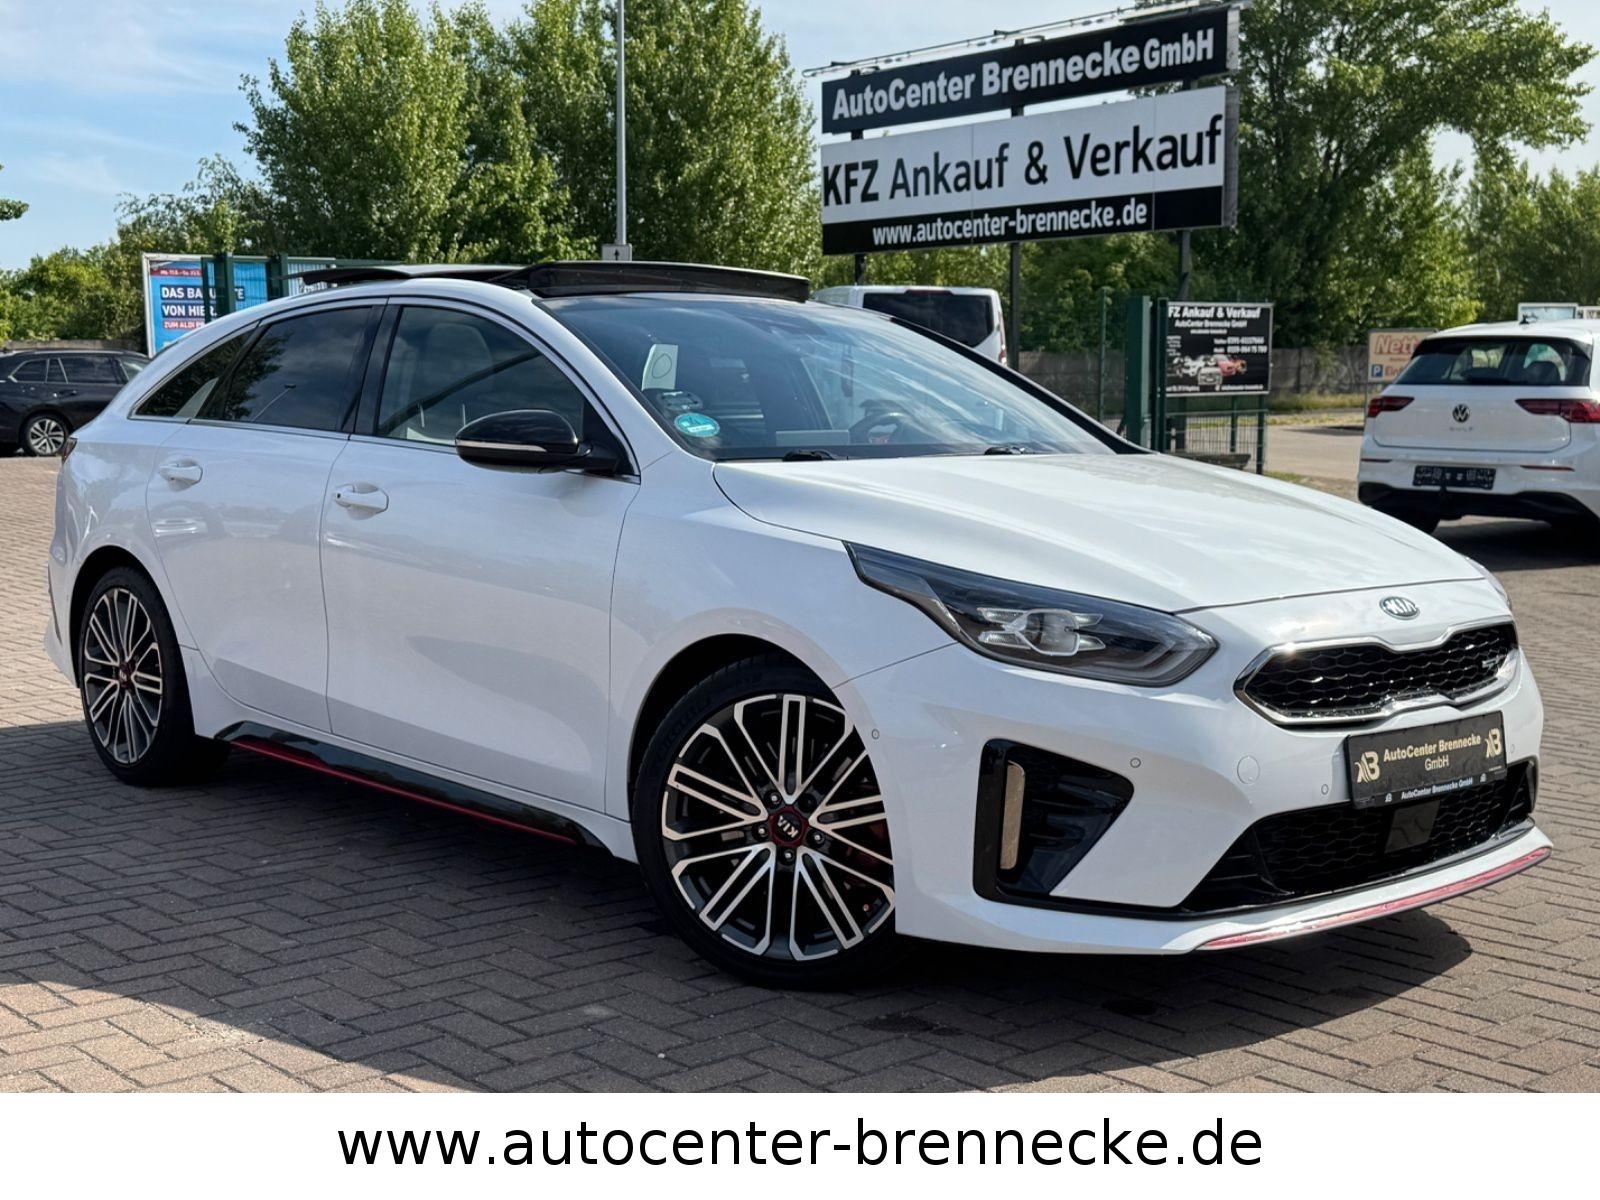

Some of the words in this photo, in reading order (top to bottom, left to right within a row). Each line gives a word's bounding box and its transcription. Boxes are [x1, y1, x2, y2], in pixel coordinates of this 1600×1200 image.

[832, 71, 976, 120] AutoCenter
[982, 40, 1140, 96] Brennecke
[1143, 28, 1215, 70] GmbH
[823, 160, 879, 207] KFZ
[889, 142, 1009, 199] Ankauf
[1024, 140, 1048, 185] &
[1064, 114, 1222, 179] Verkauf
[872, 197, 1147, 246] www.autocenter-brennecke.de
[162, 287, 185, 299] DAS
[162, 305, 186, 317] VON
[1168, 306, 1181, 318] FZ
[1182, 306, 1215, 318] Ankauf
[1226, 306, 1261, 318] Verkauf
[1374, 335, 1420, 355] Nett
[1383, 742, 1437, 763] AutoCenter
[1438, 733, 1482, 753] Brennecke
[1424, 754, 1450, 771] GmbH
